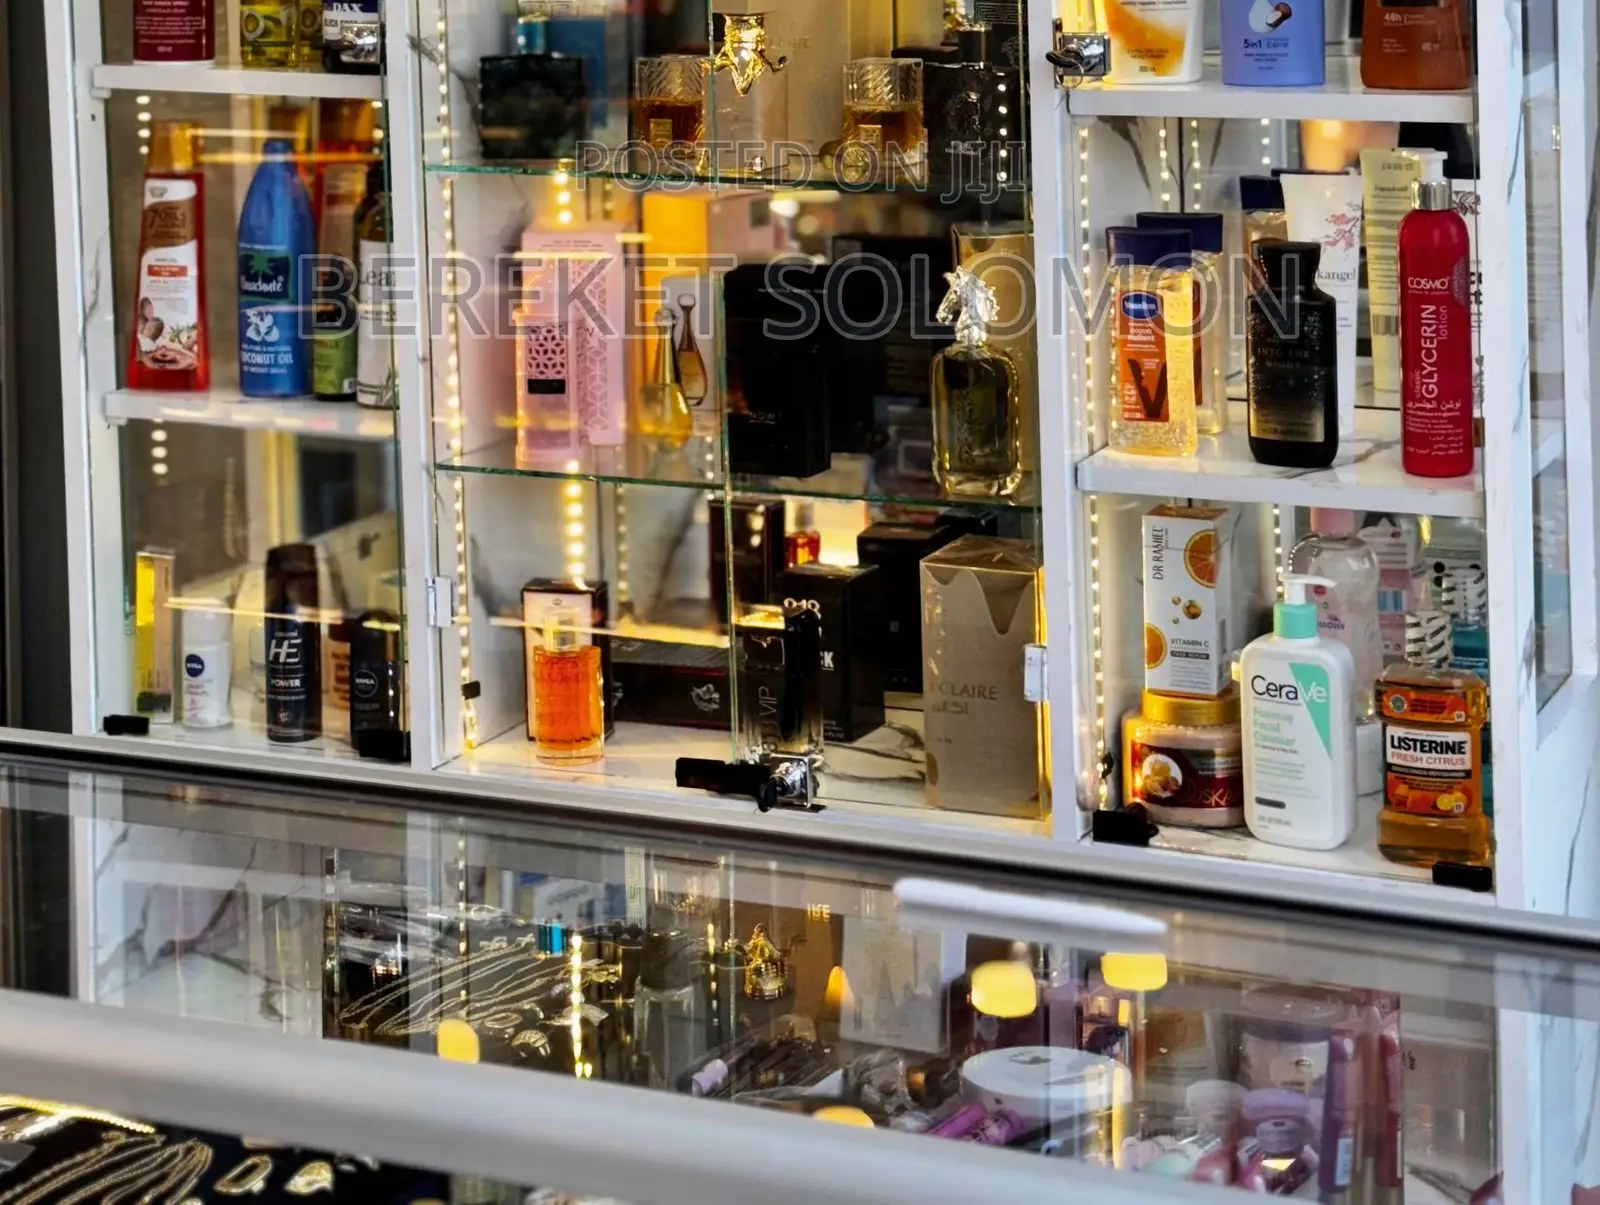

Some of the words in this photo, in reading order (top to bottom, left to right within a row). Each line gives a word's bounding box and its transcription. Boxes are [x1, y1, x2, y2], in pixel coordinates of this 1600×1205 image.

[332, 2, 363, 13] DAX
[1408, 276, 1449, 290] COSMO
[1437, 304, 1448, 340] lotion
[240, 351, 276, 365] OCONUT
[1420, 303, 1438, 399] GLYCERIN
[1152, 562, 1165, 580] DR
[1170, 637, 1203, 647] VITAMIN
[270, 678, 302, 687] POWER
[1250, 674, 1328, 704] CeraVe
[1390, 734, 1468, 756] LISTERINE
[1391, 751, 1424, 765] FRESH
[1425, 755, 1466, 767] CITRUS
